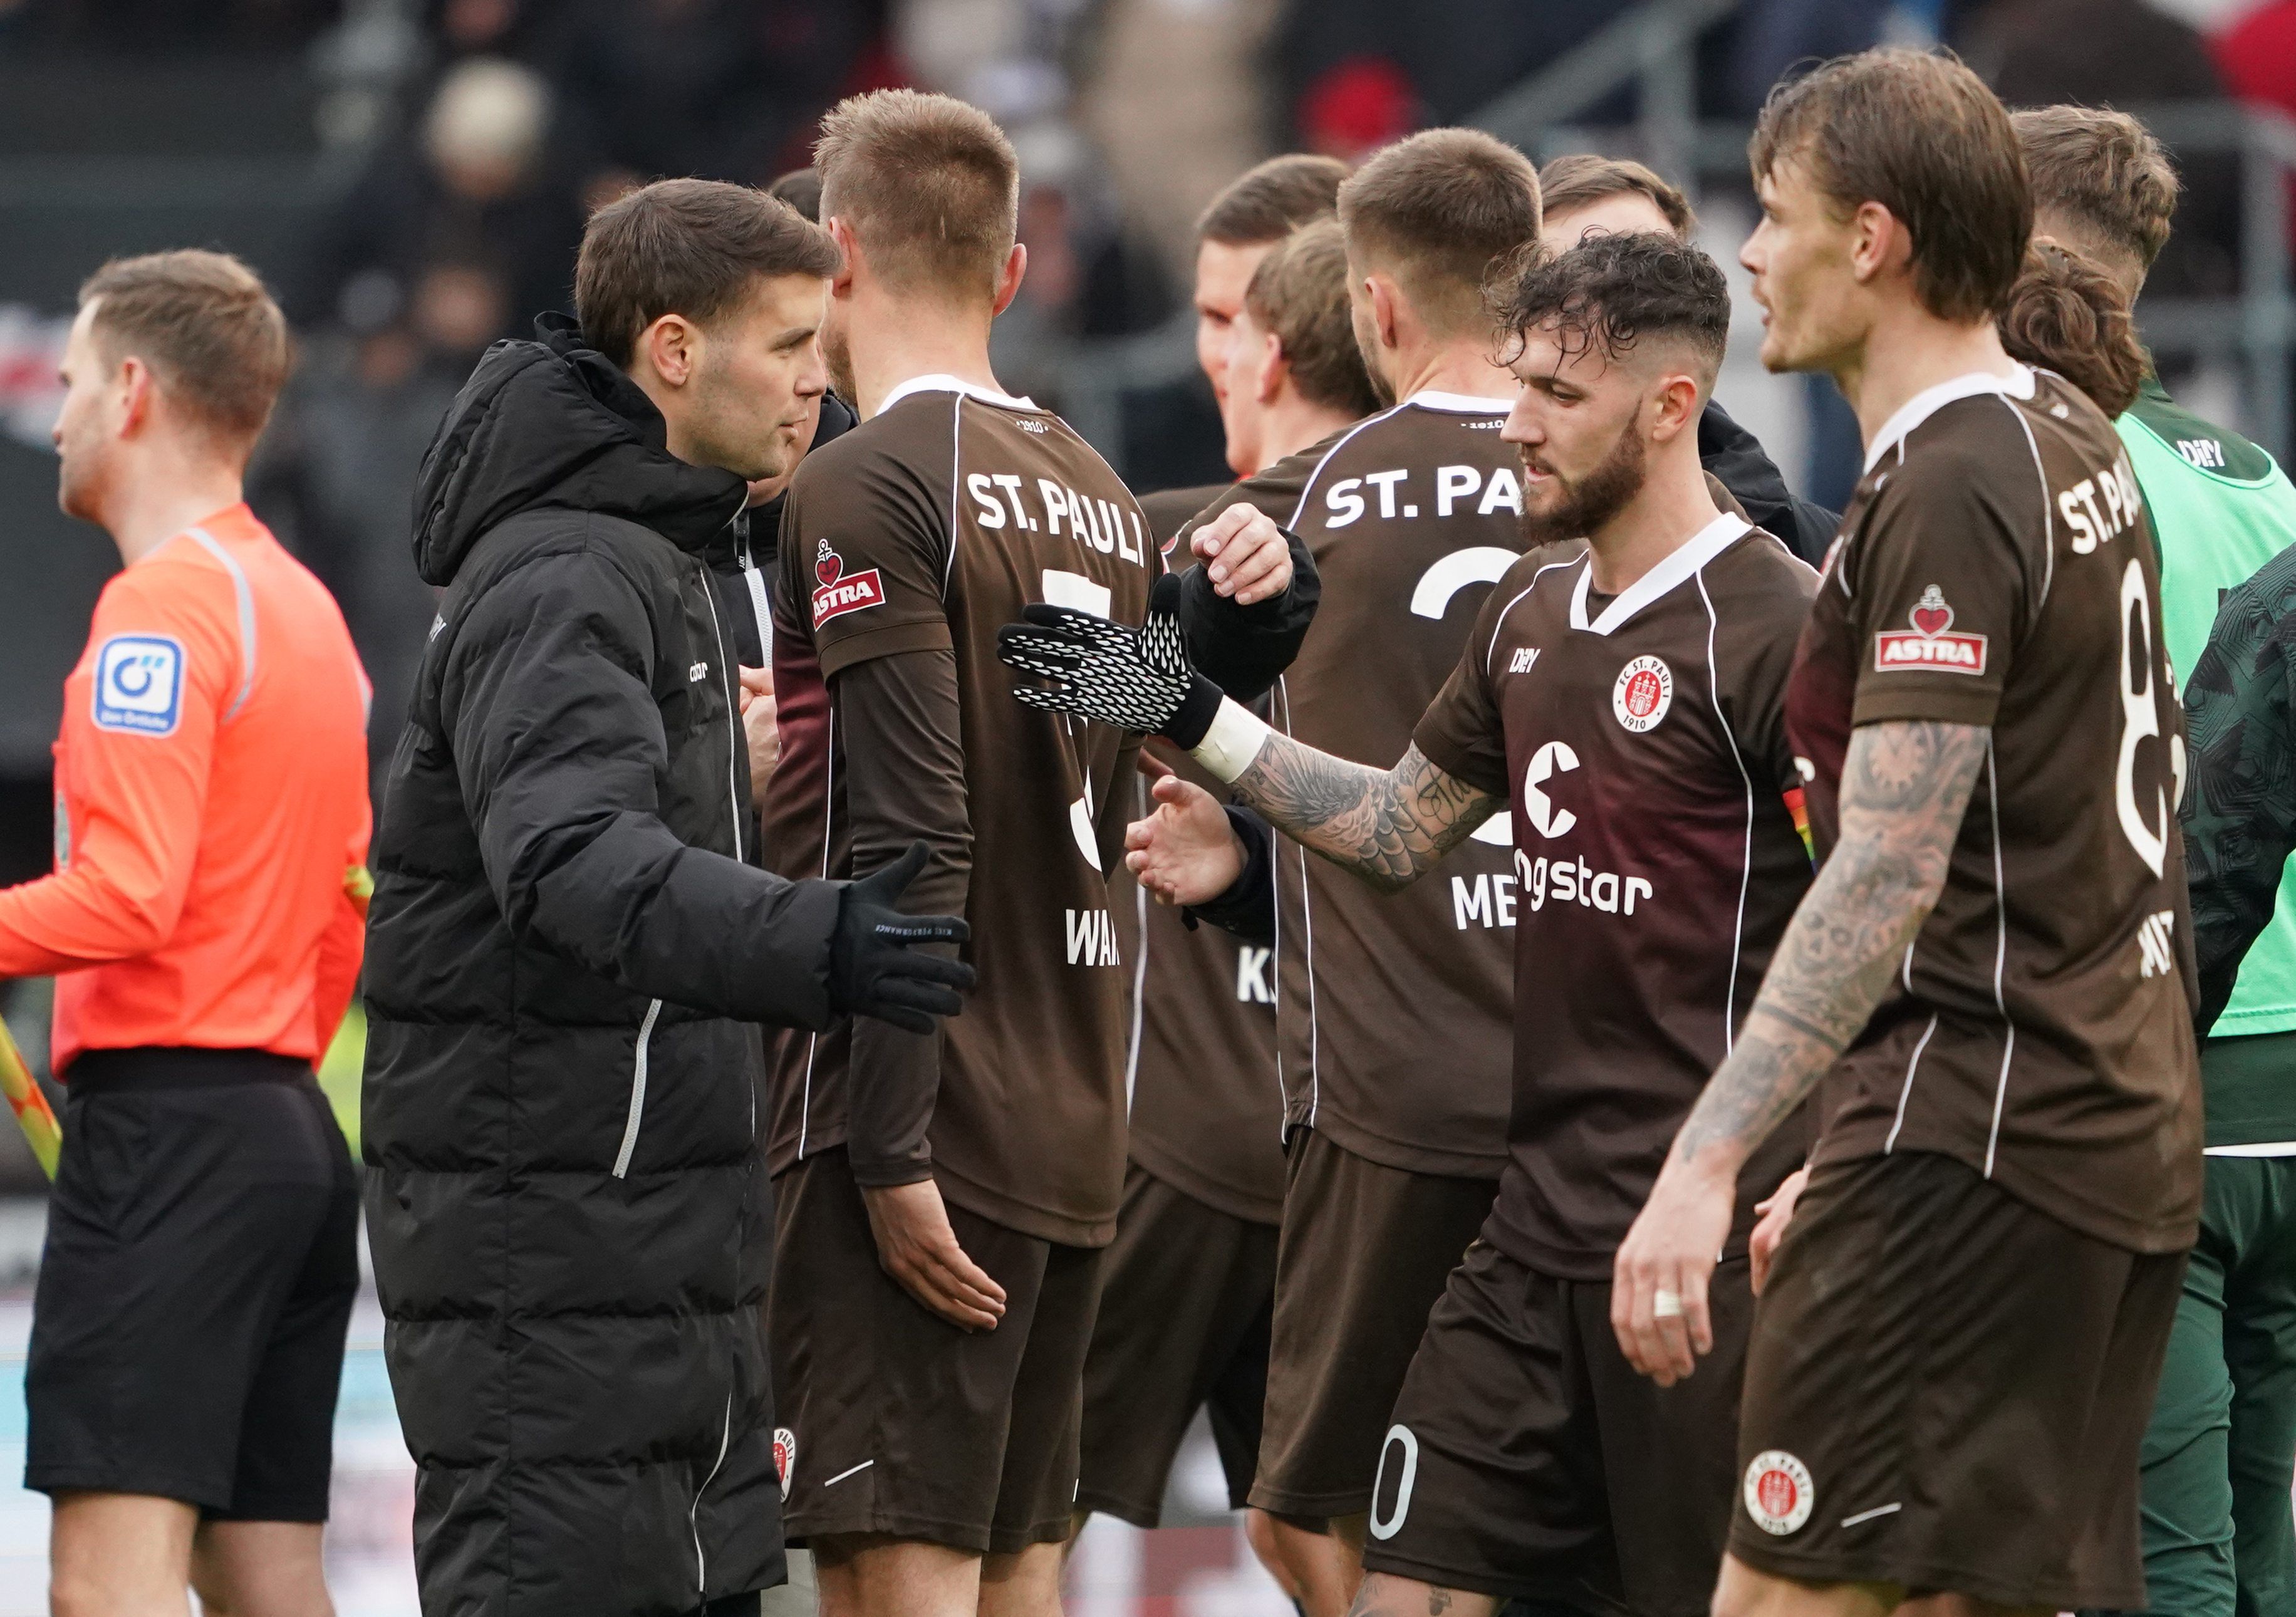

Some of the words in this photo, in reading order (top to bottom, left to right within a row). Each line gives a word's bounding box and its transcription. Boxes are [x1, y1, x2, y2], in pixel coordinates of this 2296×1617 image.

[967, 474, 1037, 532] ST.
[1039, 479, 1145, 568] PAULI
[1326, 469, 1418, 528] ST.
[2059, 479, 2114, 555] ST.
[813, 581, 875, 620] ASTRA
[1619, 671, 1630, 686] FC
[1633, 658, 1647, 672] ST.
[1651, 660, 1670, 698] PAULI
[1883, 637, 1977, 665] ASTRA
[1623, 715, 1646, 729] 1910
[1451, 874, 1519, 930] ME
[1514, 848, 1653, 916] ngstar
[1237, 945, 1276, 1004] K
[777, 1431, 794, 1460] PAULI
